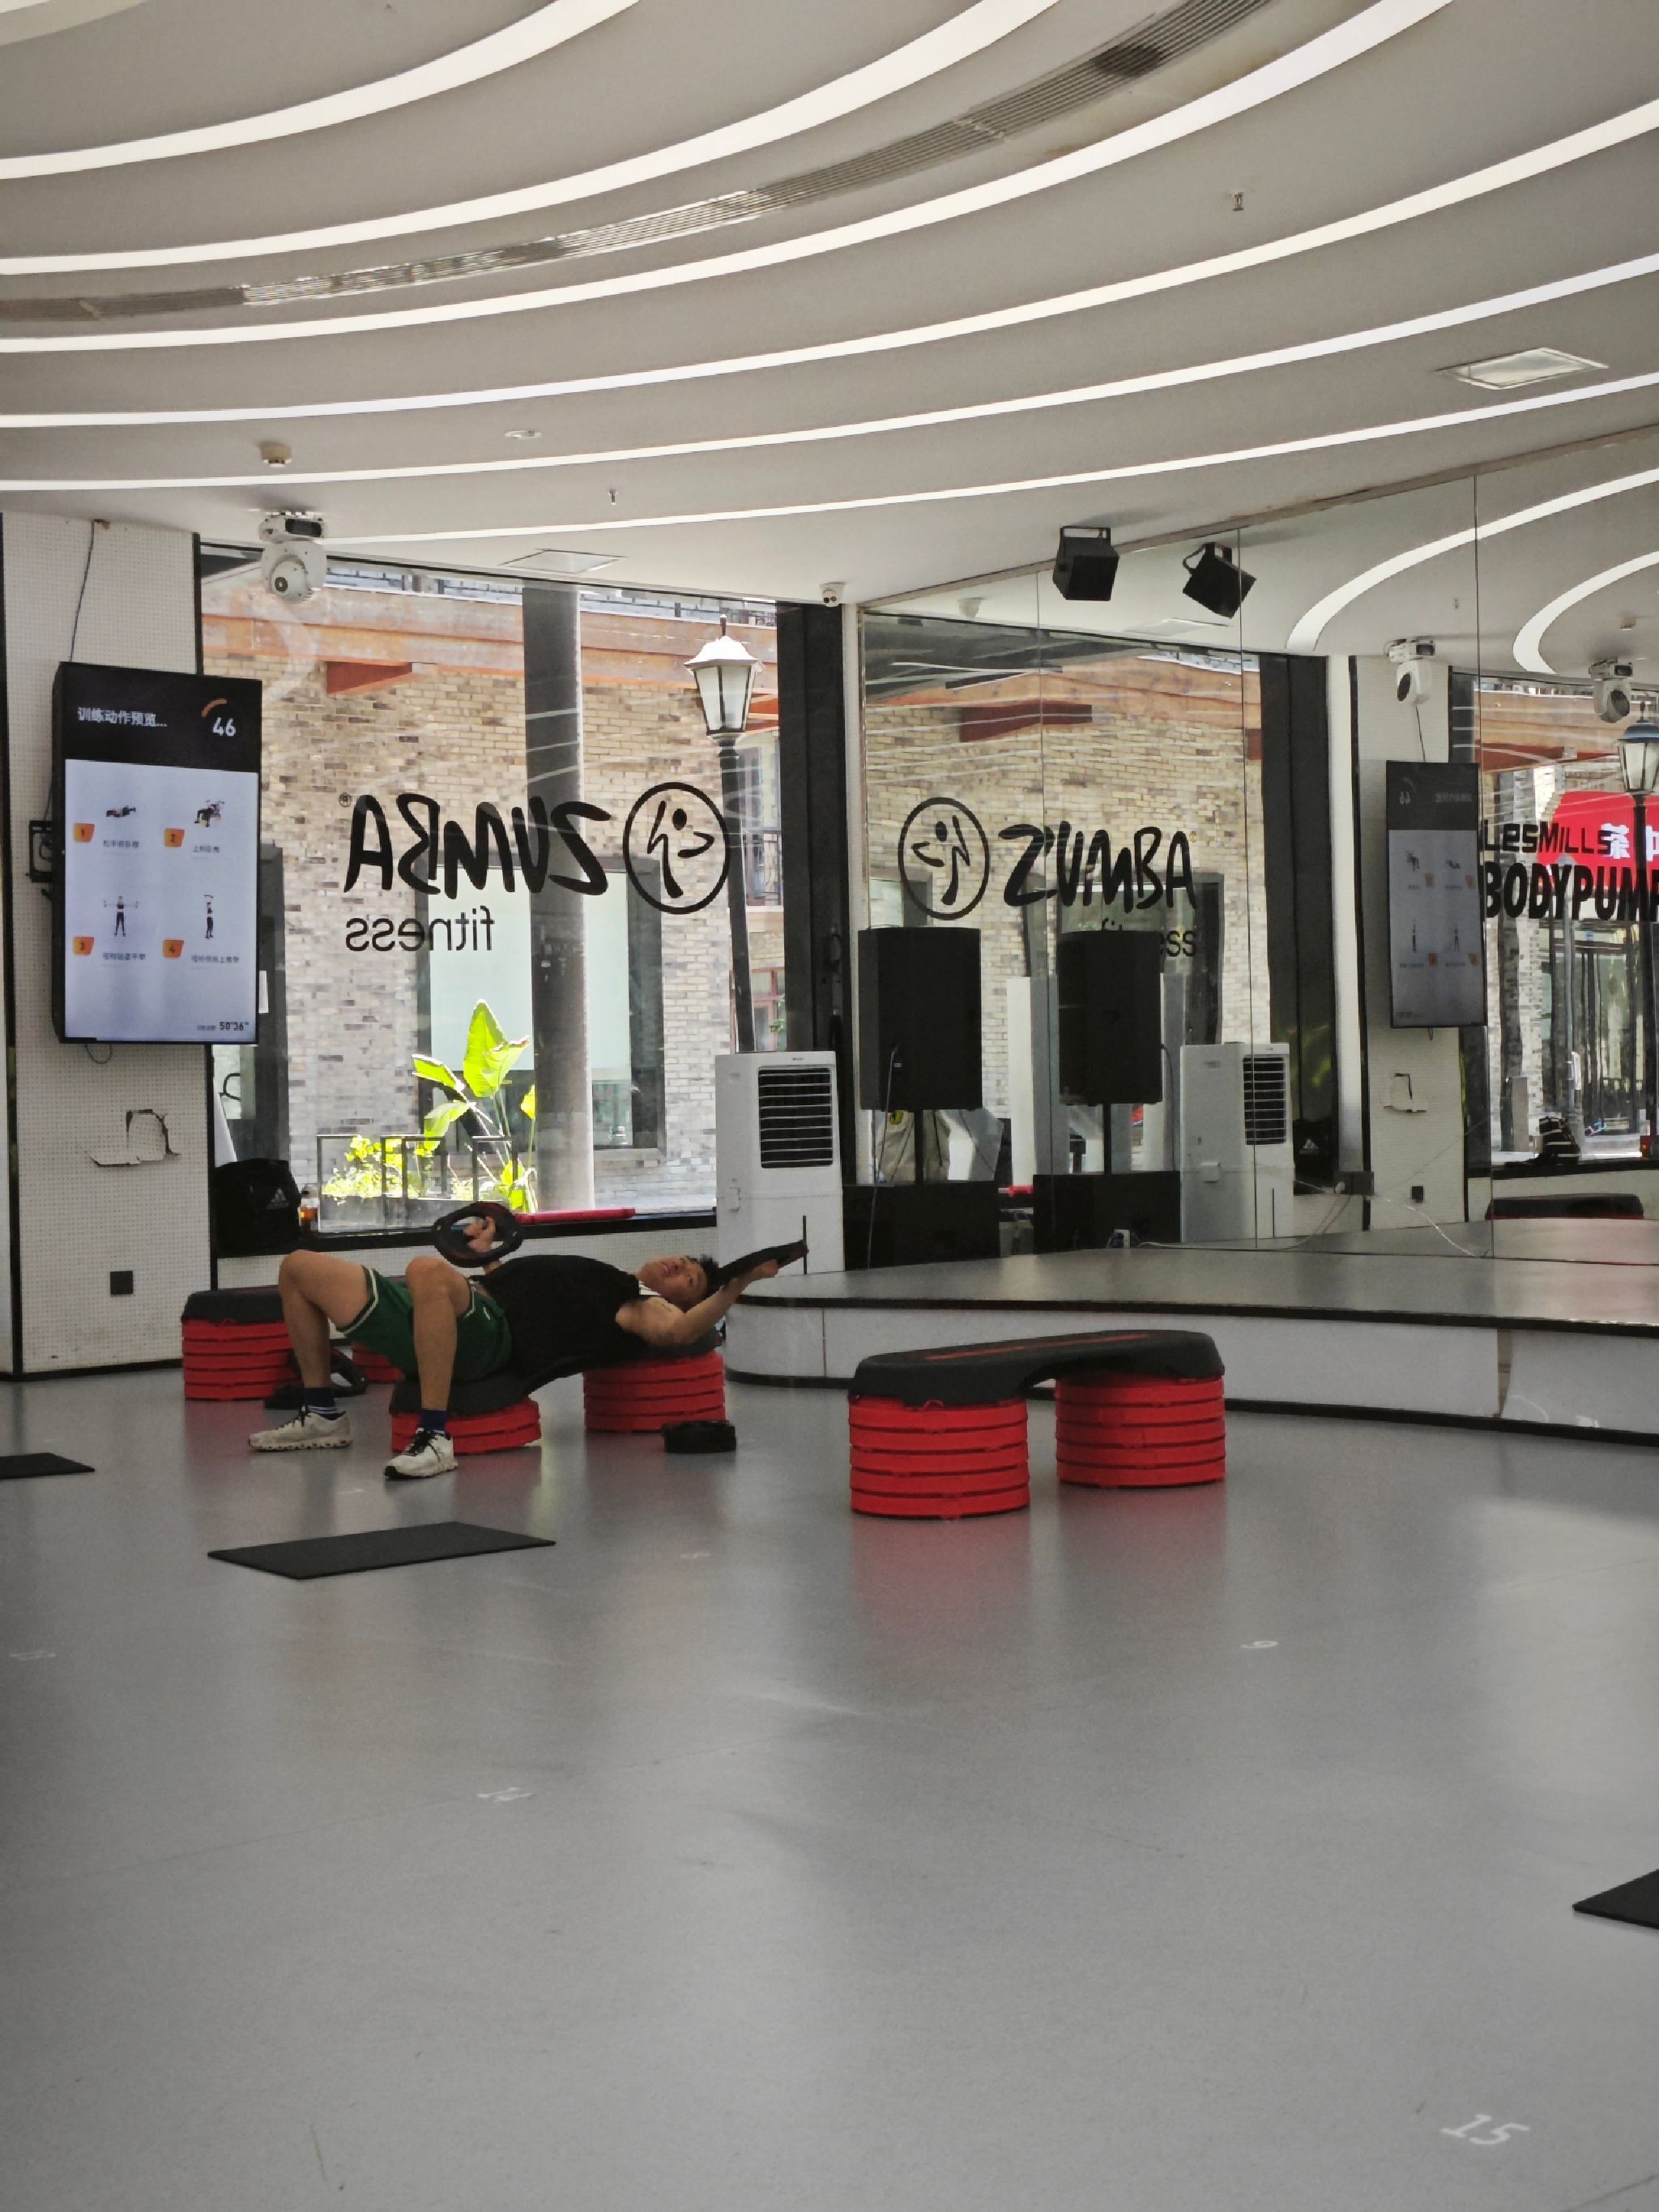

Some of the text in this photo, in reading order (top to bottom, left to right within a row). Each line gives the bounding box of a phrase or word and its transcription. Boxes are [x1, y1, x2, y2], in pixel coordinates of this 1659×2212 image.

[212, 716, 237, 737] 46
[998, 820, 1196, 914] ZUMBA
[1440, 2113, 1529, 2145] 15
